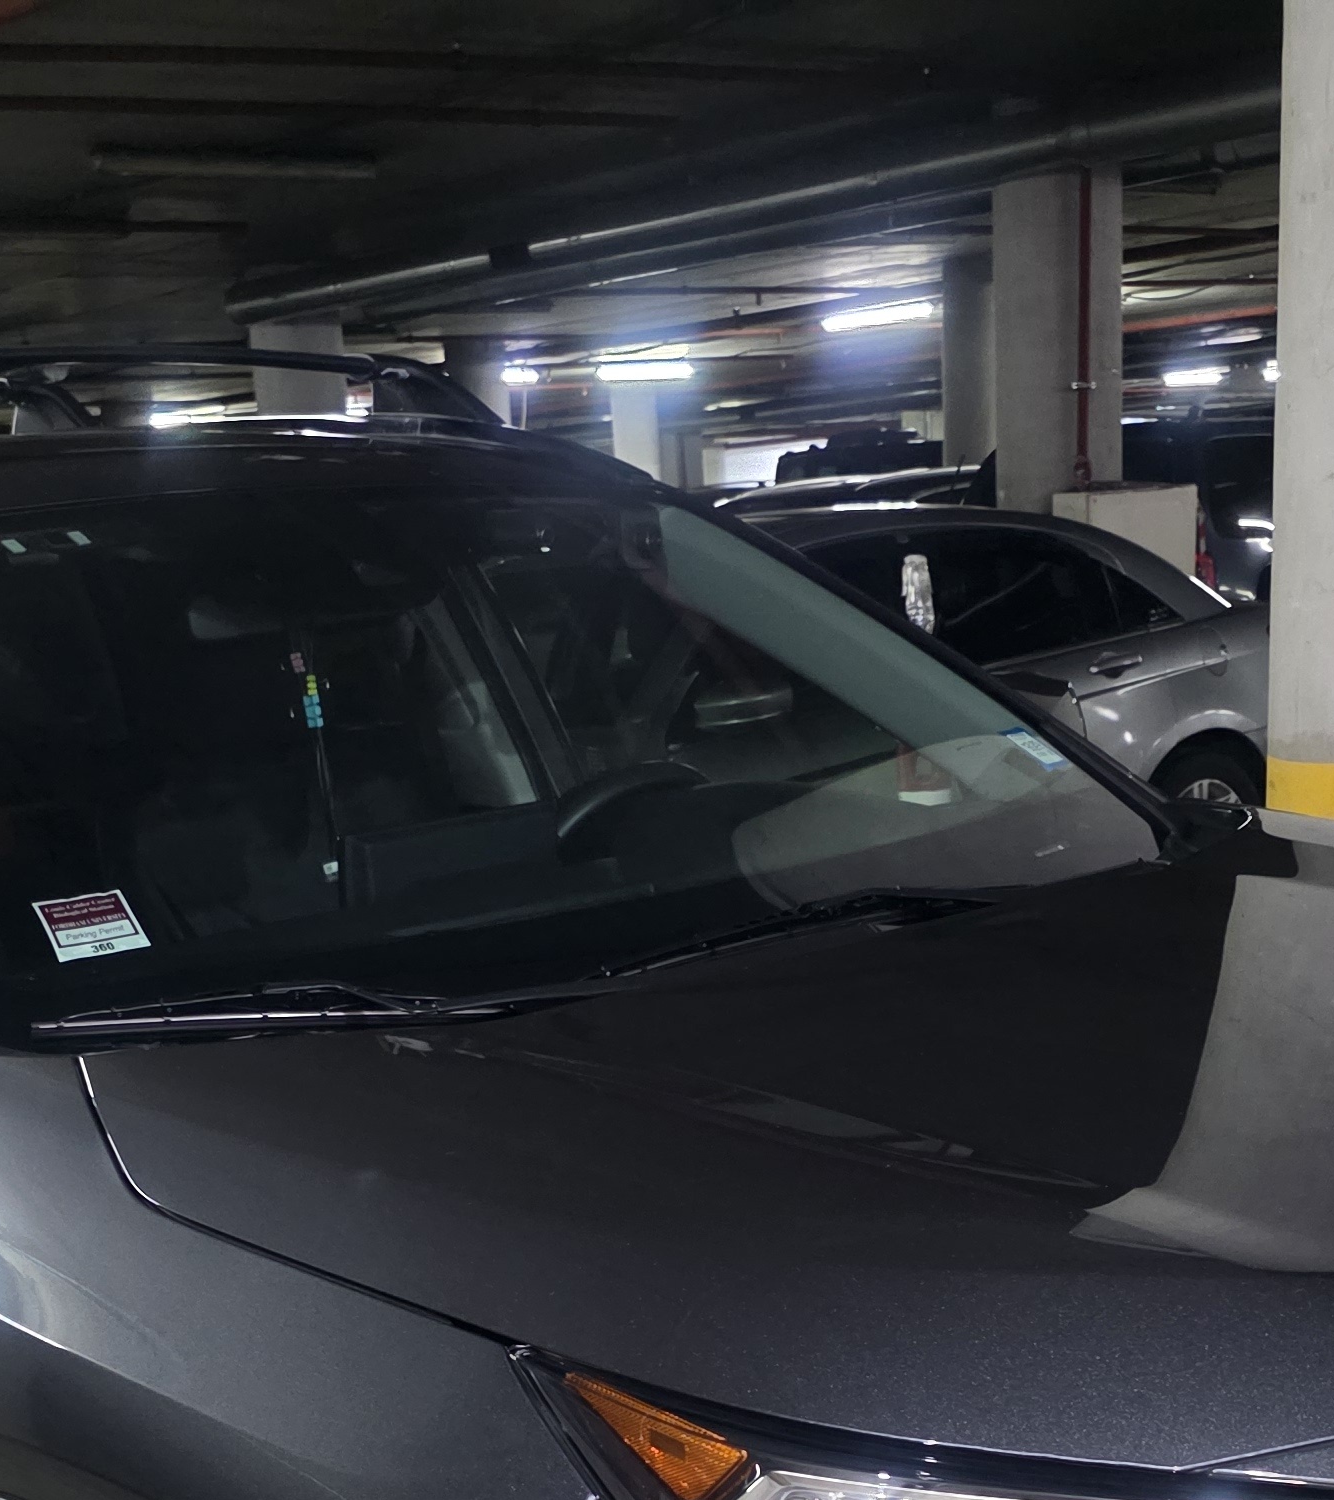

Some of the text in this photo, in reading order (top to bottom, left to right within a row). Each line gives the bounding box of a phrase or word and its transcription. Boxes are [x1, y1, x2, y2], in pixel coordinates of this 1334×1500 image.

[65, 924, 125, 941] Parking Permit
[91, 942, 115, 953] 360
